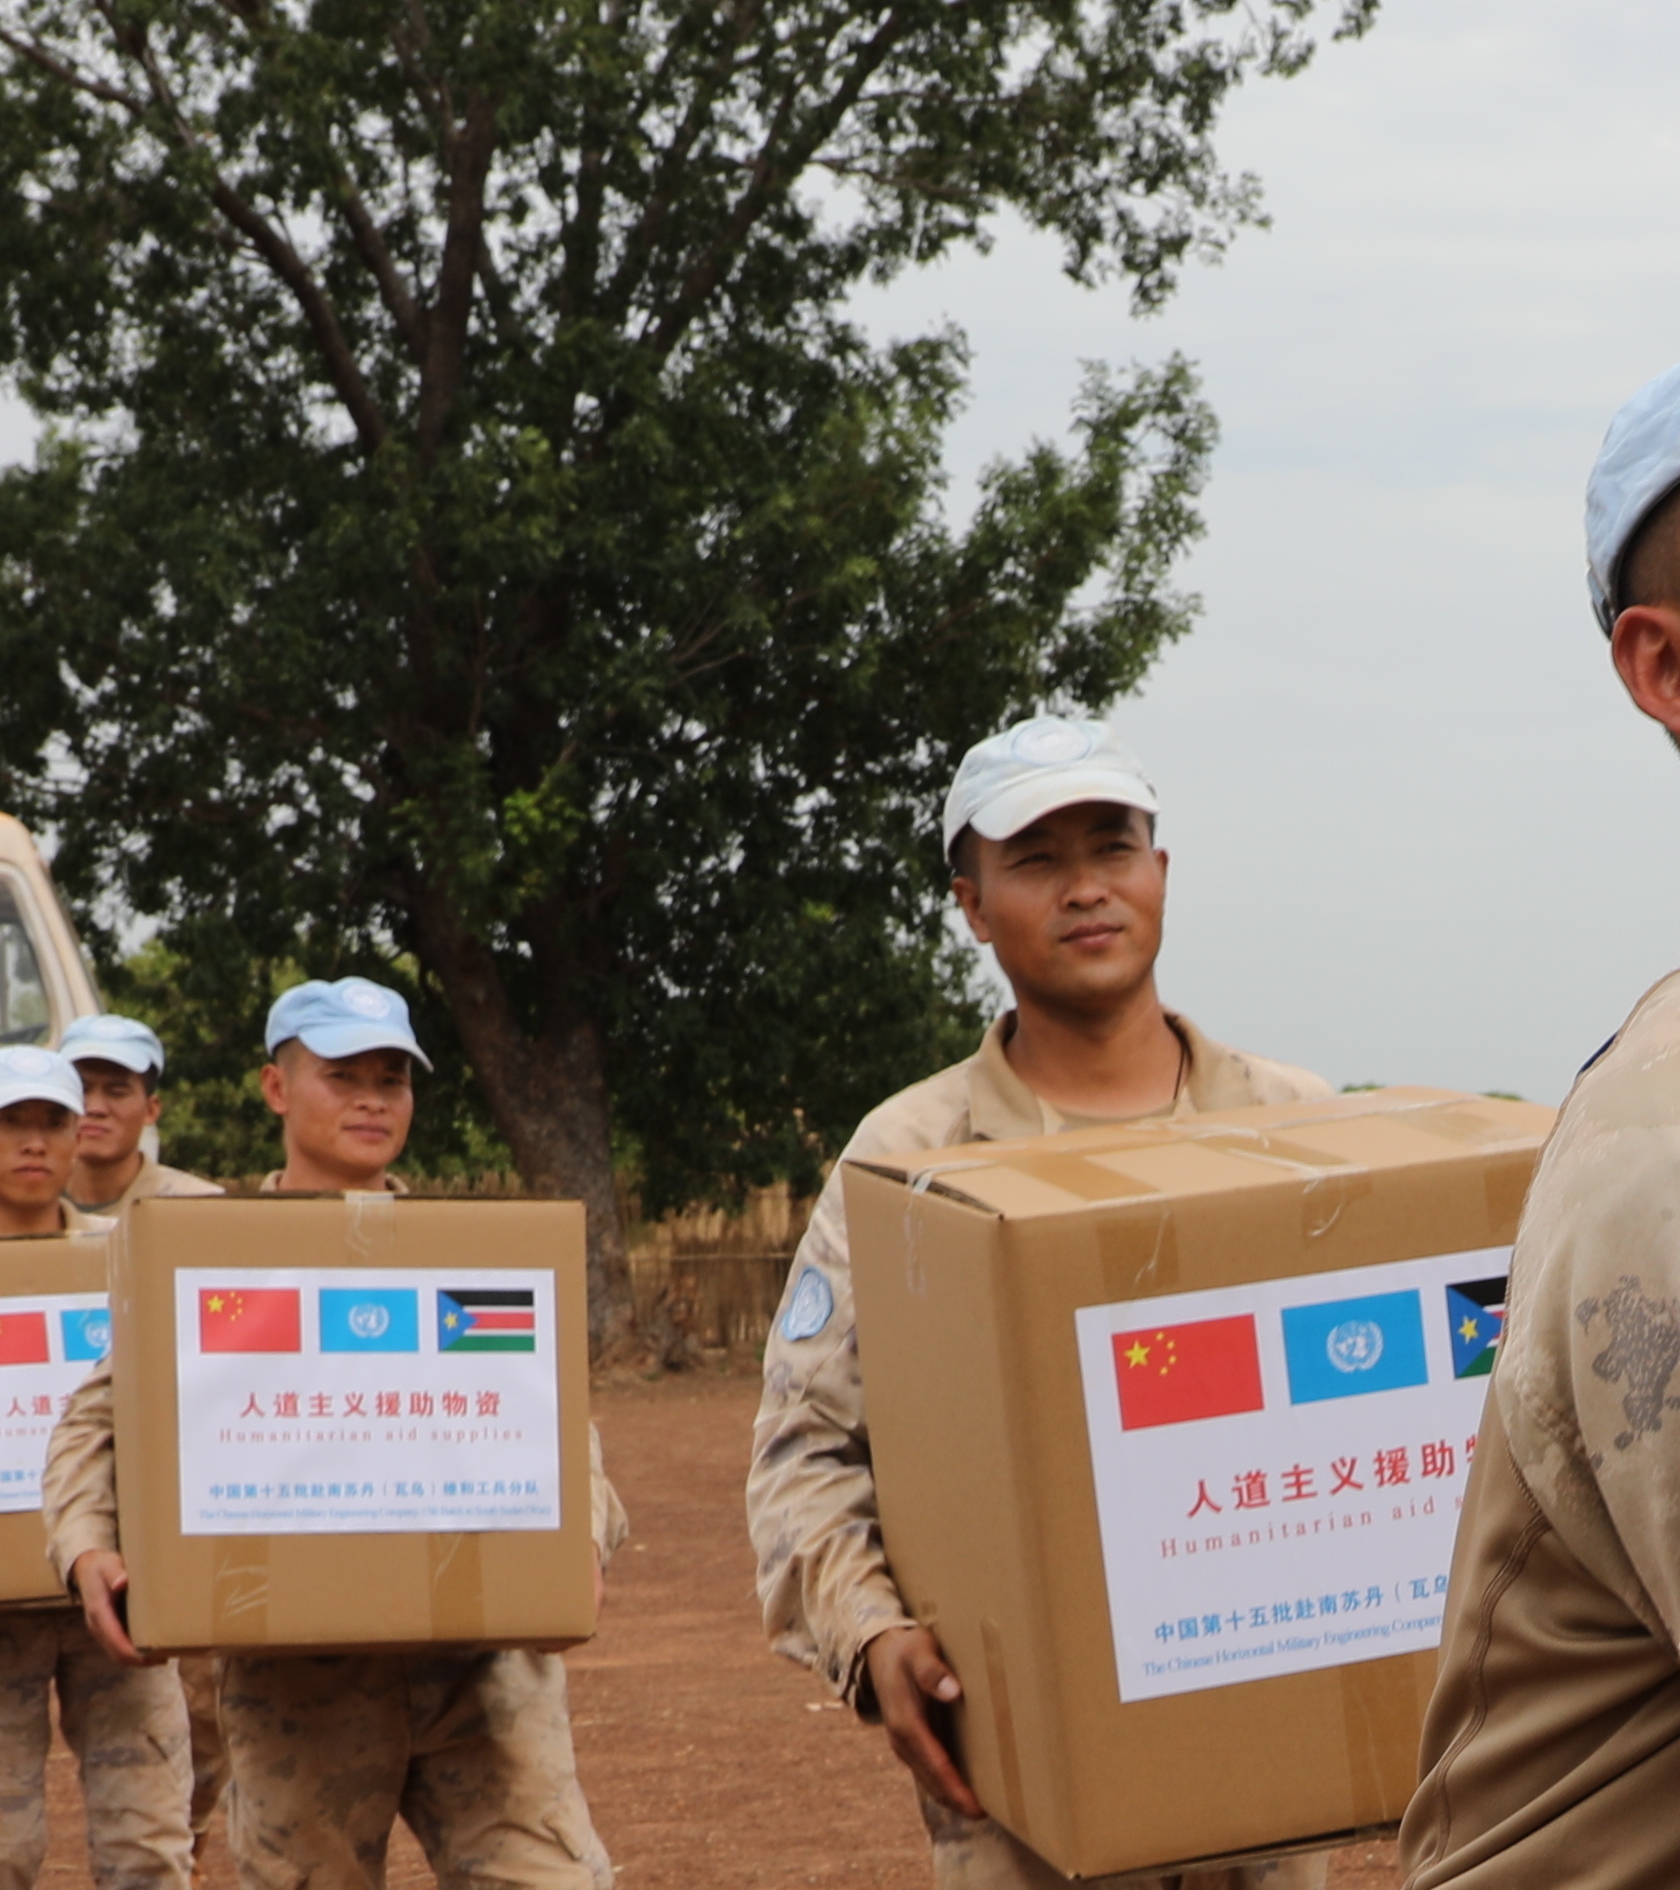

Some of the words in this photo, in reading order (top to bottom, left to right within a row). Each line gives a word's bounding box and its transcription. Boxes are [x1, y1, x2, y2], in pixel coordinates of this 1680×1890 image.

[239, 1390, 502, 1420] 人道主义援助物资
[1160, 1510, 1372, 1559] Humanitarian
[1391, 1496, 1436, 1521] aid
